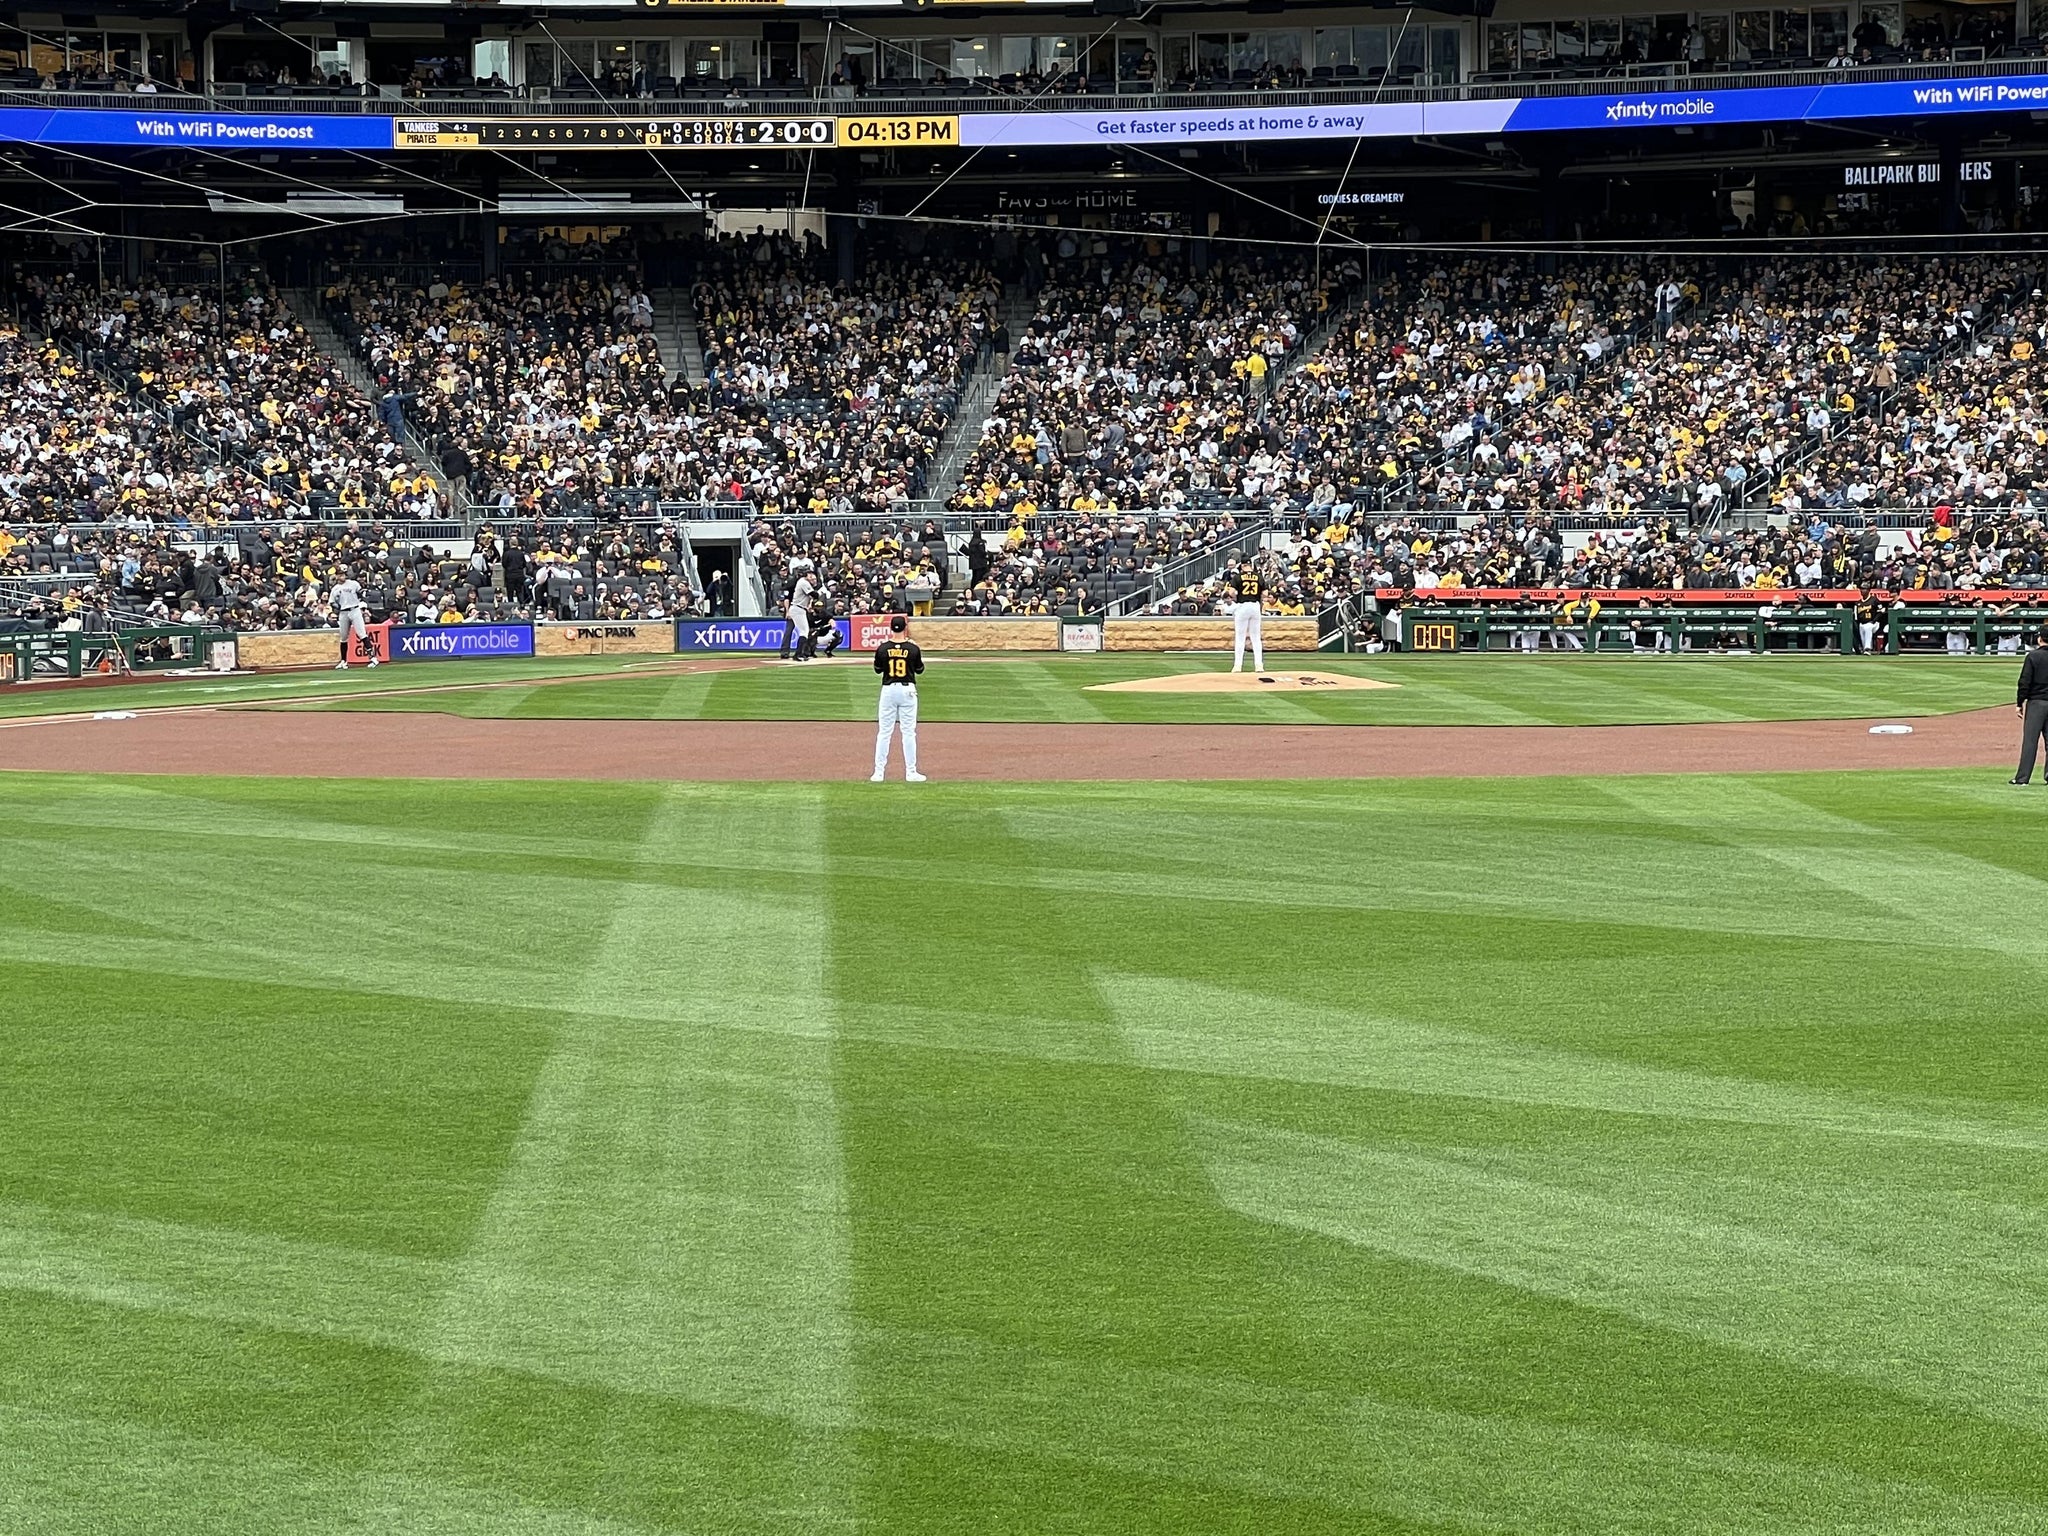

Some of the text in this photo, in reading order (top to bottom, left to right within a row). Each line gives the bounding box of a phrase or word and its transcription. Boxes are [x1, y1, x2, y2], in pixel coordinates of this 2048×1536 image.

[1913, 88, 1953, 104] With
[1957, 86, 1993, 102] WiFi
[1606, 98, 1715, 120] xfinity mobile
[136, 120, 314, 140] With WiFi PowerBoost
[403, 122, 440, 132] YANKEES
[649, 122, 744, 132] 0 0 0 0 4
[750, 129, 757, 137] B
[758, 122, 775, 143] 2
[776, 129, 783, 137] S
[784, 122, 801, 143] 0
[810, 122, 828, 143] 0
[847, 121, 951, 141] 04:13 PM
[1097, 114, 1365, 136] Get faster speeds at home & away
[406, 134, 437, 144] PIRATES
[497, 128, 504, 138] 2
[514, 128, 521, 138] 3
[531, 128, 539, 138] 4
[549, 128, 556, 138] 5
[565, 128, 573, 138] 6
[583, 128, 590, 138] 7
[600, 128, 608, 138] 8
[617, 128, 624, 138] 9
[636, 129, 643, 137] R
[650, 134, 744, 144] 0 0 0 0 4
[663, 129, 671, 137] H
[684, 129, 691, 137] E
[1844, 165, 1914, 186] BALLPARK
[1352, 194, 1360, 204] &
[1360, 193, 1405, 204] CREAMERY
[1242, 581, 1259, 596] 23
[578, 627, 636, 638] PNC PARK
[694, 624, 761, 647] xfinity
[401, 629, 519, 654] xfinity mobile
[888, 658, 907, 677] 19
